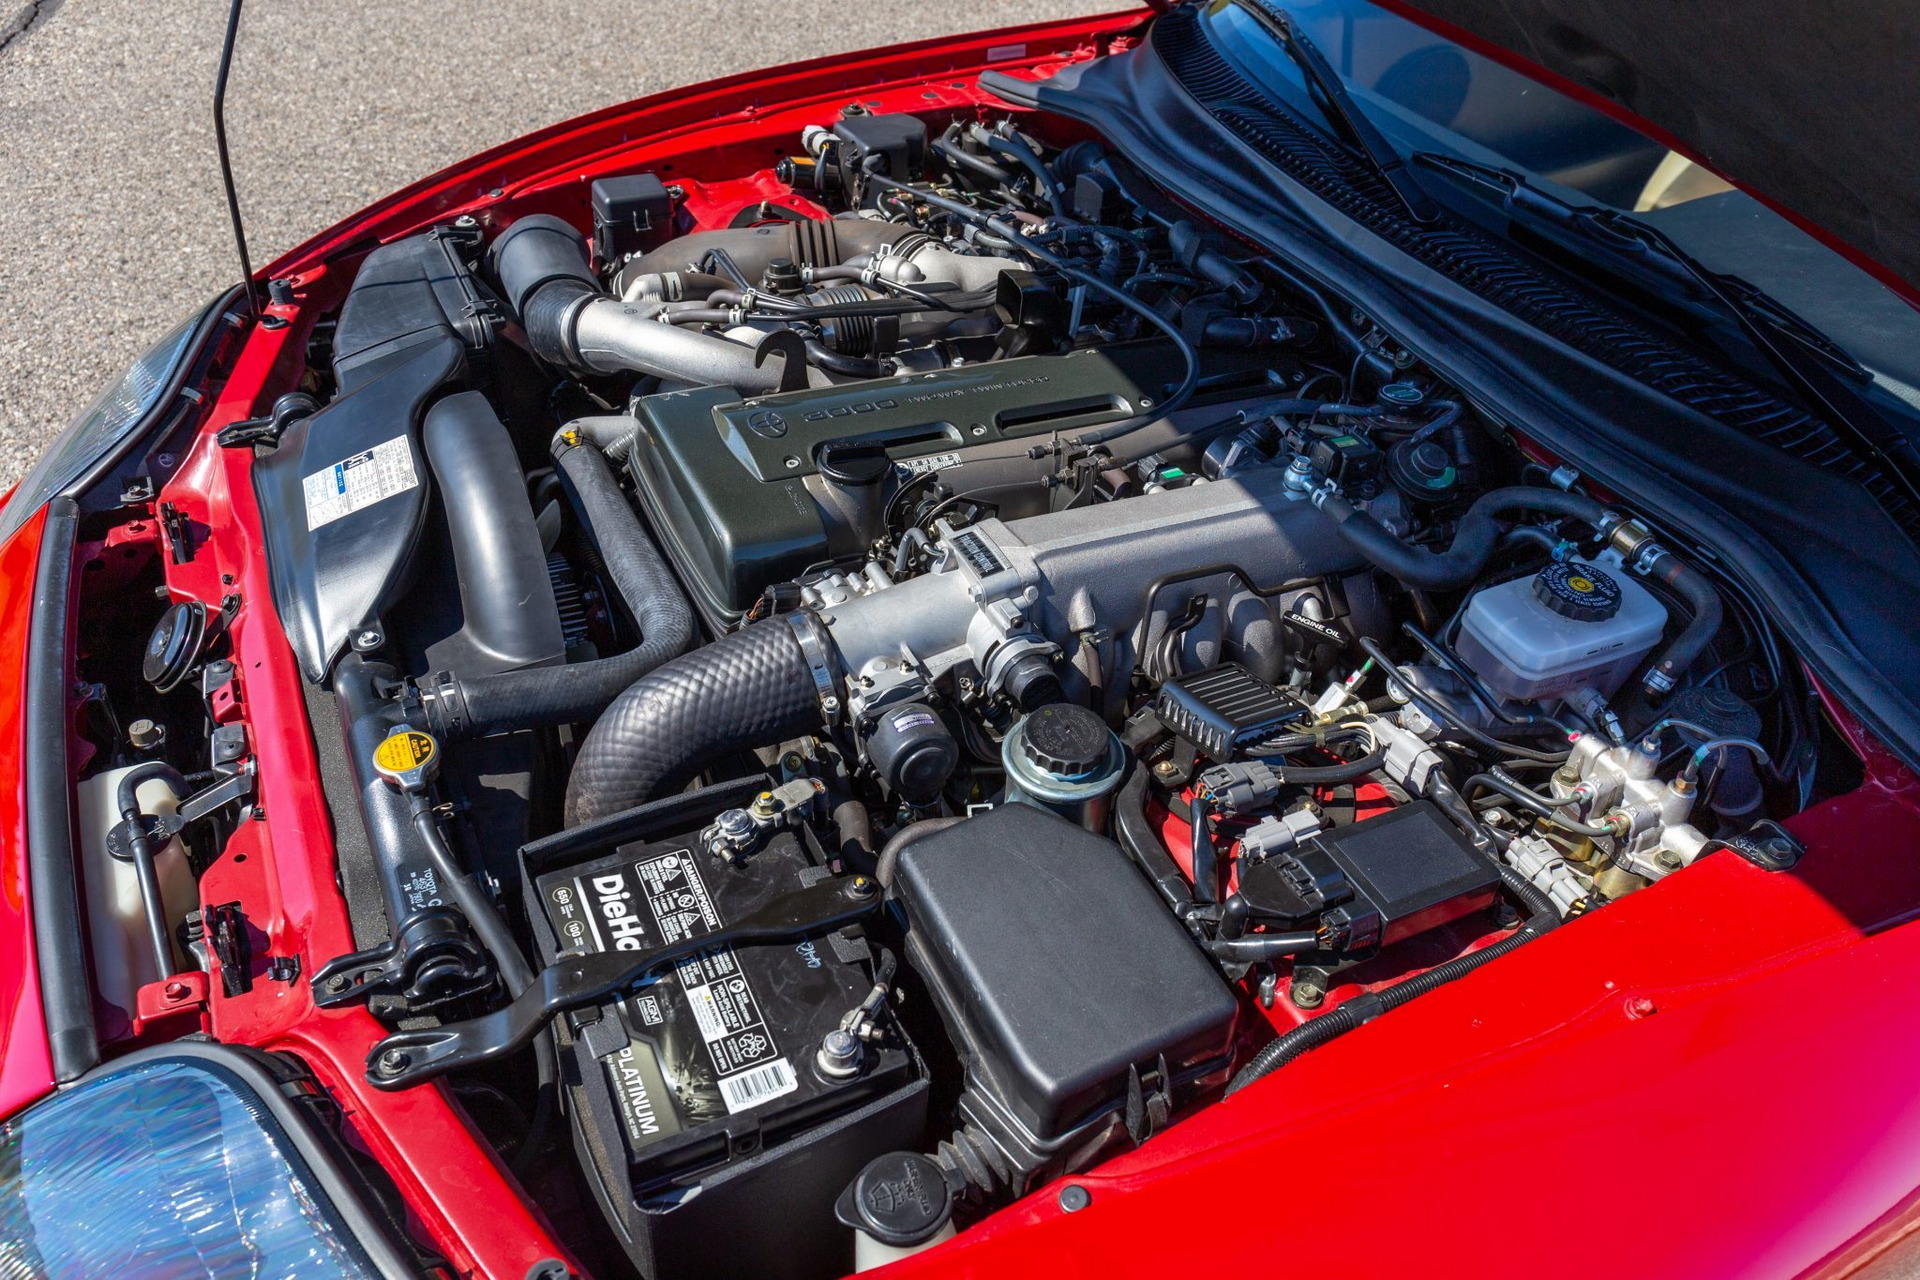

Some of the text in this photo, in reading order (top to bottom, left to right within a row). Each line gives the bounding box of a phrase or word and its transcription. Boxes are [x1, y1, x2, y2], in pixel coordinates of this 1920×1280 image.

[1573, 564, 1596, 582] BRAKE
[1594, 581, 1615, 597] FLUID
[1291, 613, 1341, 638] ENGINE OIL
[422, 867, 438, 895] TOYOTA
[556, 888, 570, 904] 650
[683, 863, 717, 926] DANGER/POISON
[592, 874, 645, 951] DieHa
[567, 922, 581, 937] 100
[644, 998, 660, 1021] AGM
[716, 983, 740, 1028] NON-SPILLABLE
[618, 1048, 659, 1135] PLATINUM
